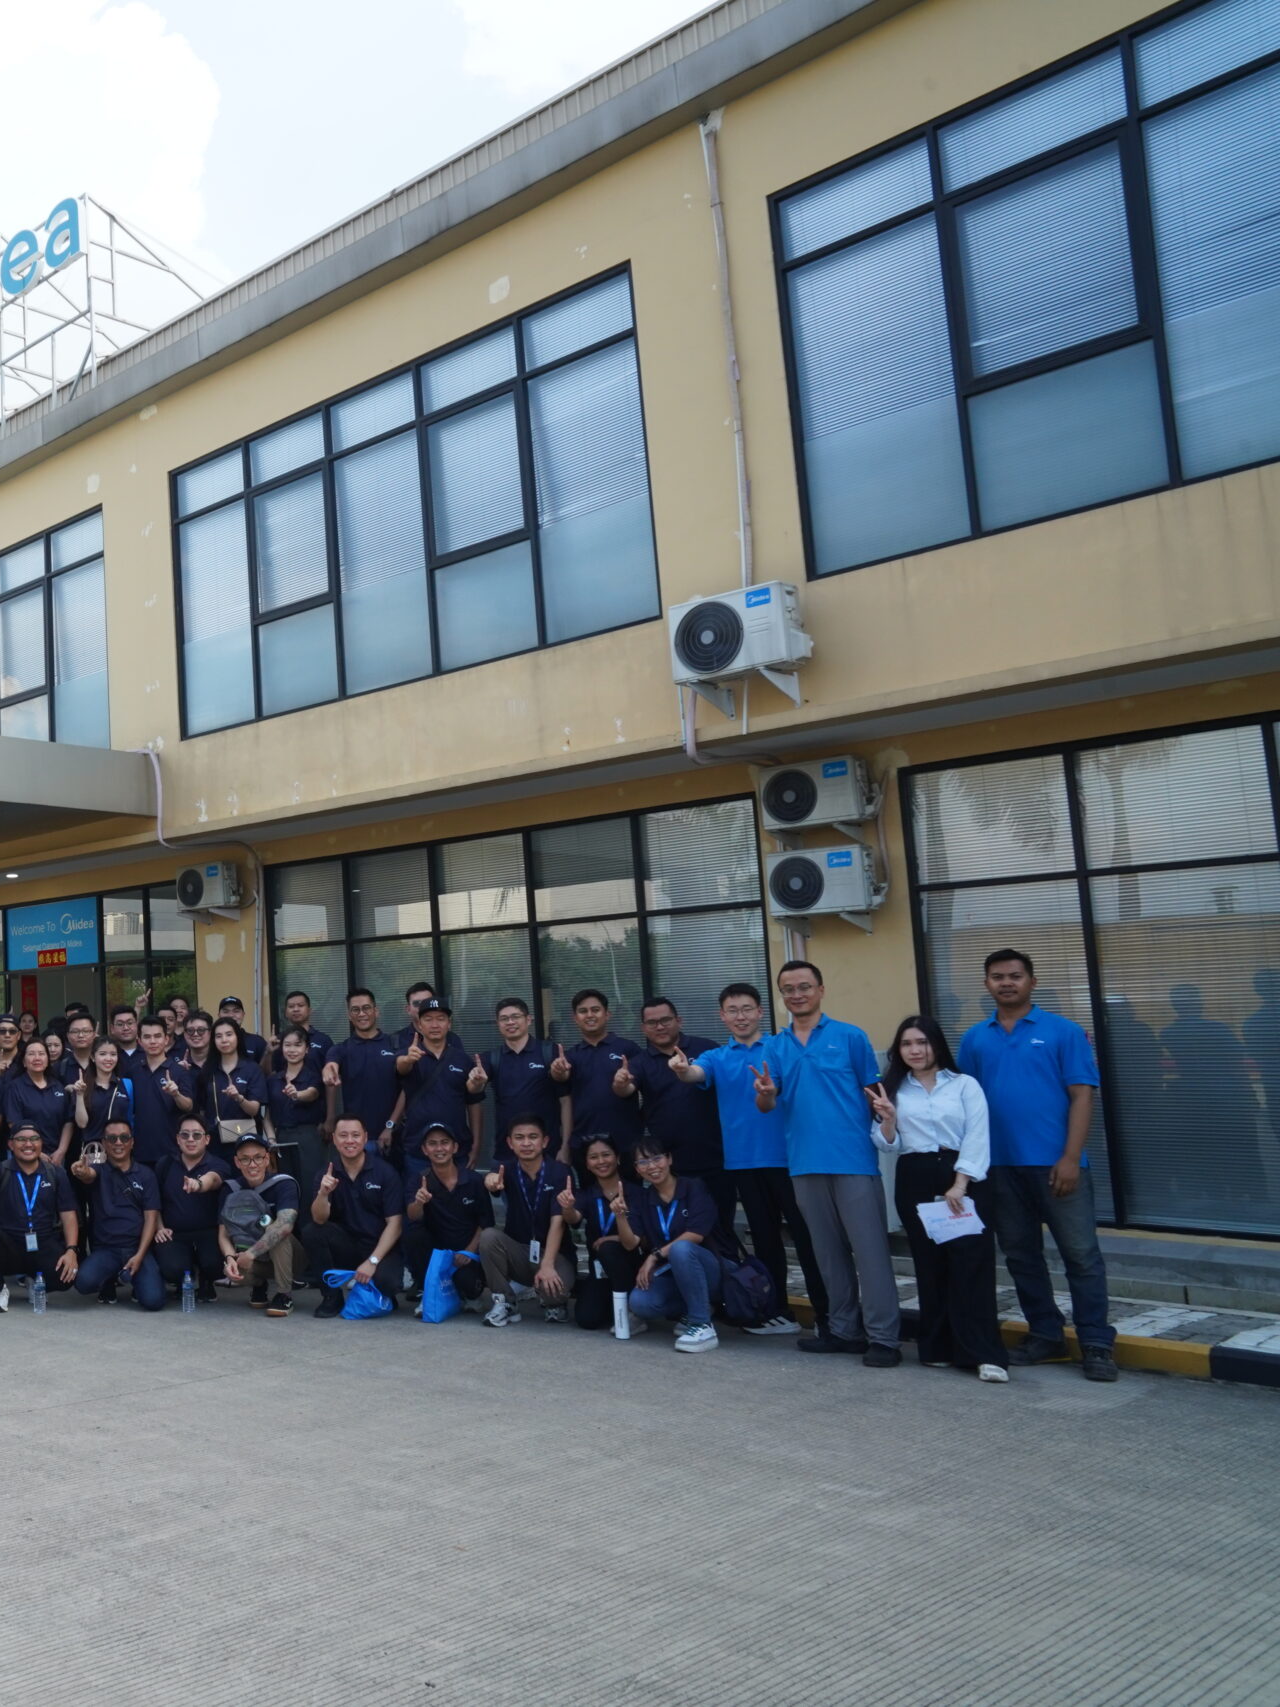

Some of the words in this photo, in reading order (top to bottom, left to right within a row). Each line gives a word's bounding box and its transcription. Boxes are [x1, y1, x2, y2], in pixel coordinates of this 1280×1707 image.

[10, 924, 45, 936] Welcome
[47, 921, 56, 932] To
[60, 913, 94, 934] Midea
